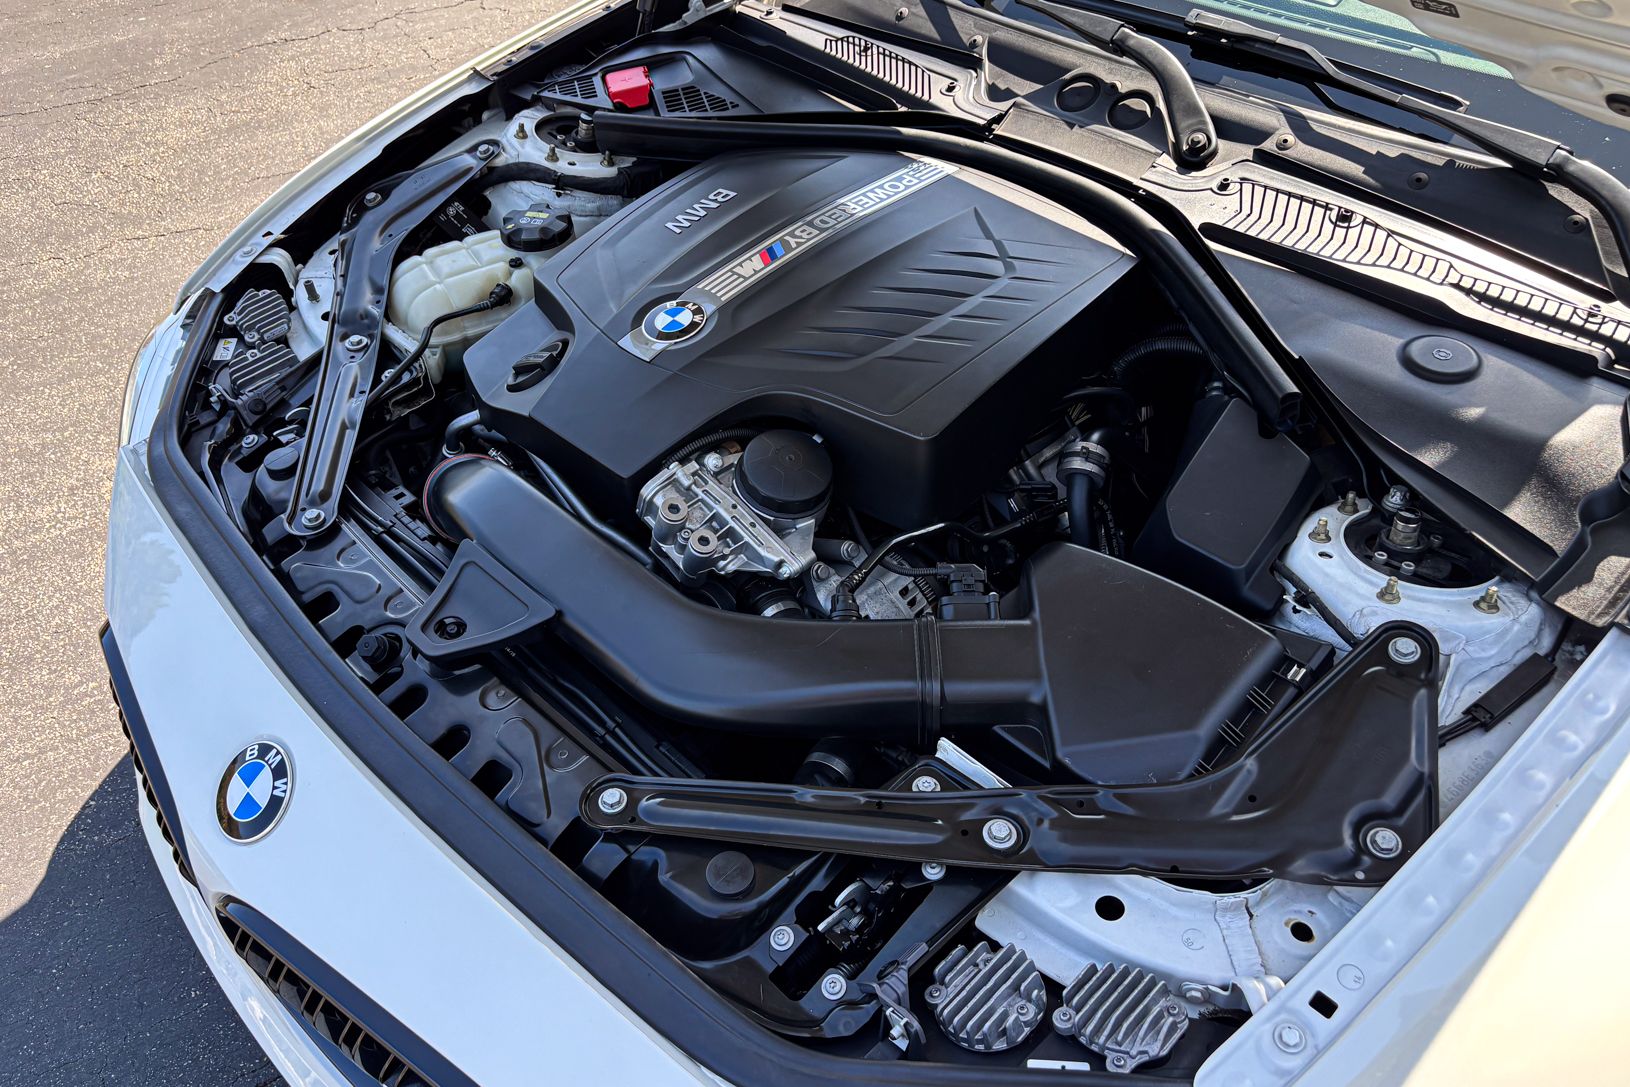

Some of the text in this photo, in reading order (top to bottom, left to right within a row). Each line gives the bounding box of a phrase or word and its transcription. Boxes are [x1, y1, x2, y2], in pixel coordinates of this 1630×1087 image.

[664, 188, 738, 234] BMW
[813, 174, 919, 228] POWERED
[783, 225, 820, 249] BY
[666, 300, 704, 323] BMW
[245, 744, 288, 798] BMW
